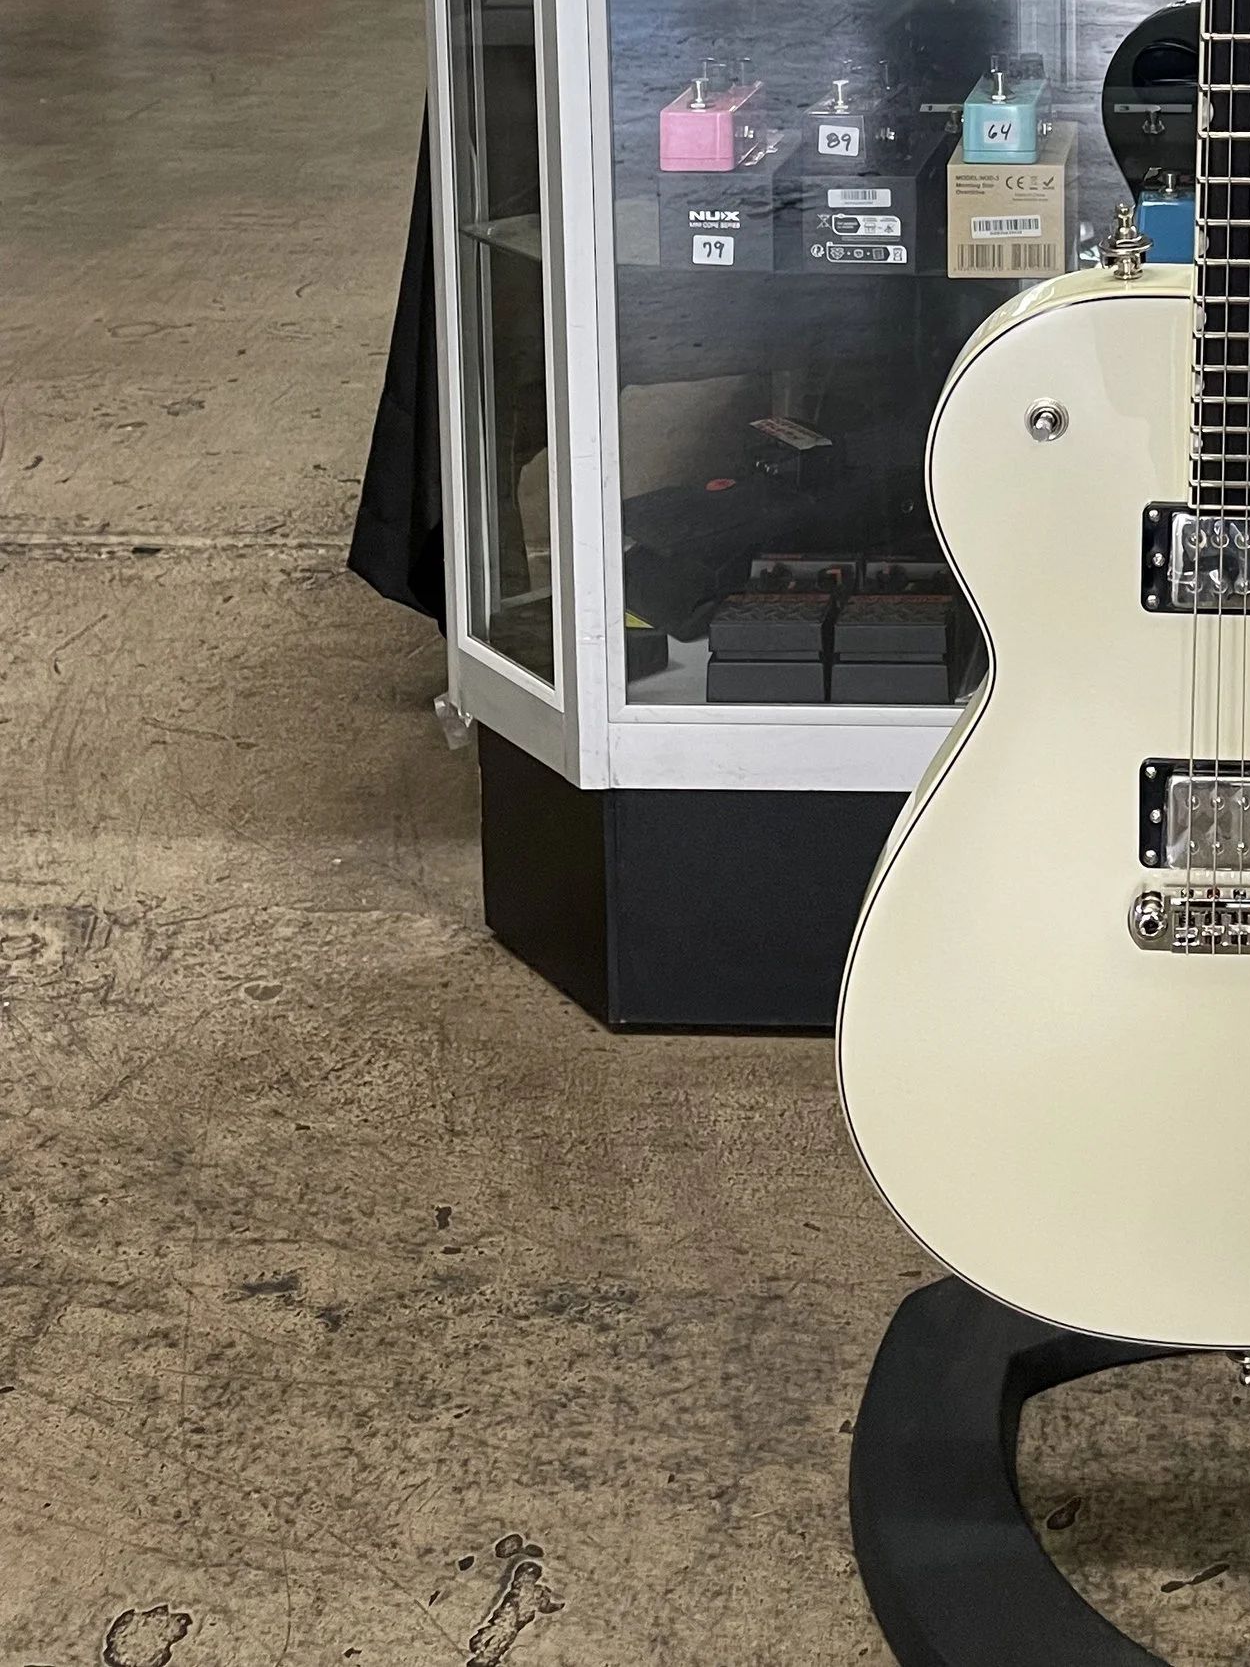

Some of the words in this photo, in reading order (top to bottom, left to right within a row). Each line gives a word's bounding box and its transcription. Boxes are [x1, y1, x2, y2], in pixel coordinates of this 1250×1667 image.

[986, 122, 1012, 141] 64
[826, 132, 852, 152] 89
[689, 210, 741, 221] NUX
[702, 240, 725, 259] 79
